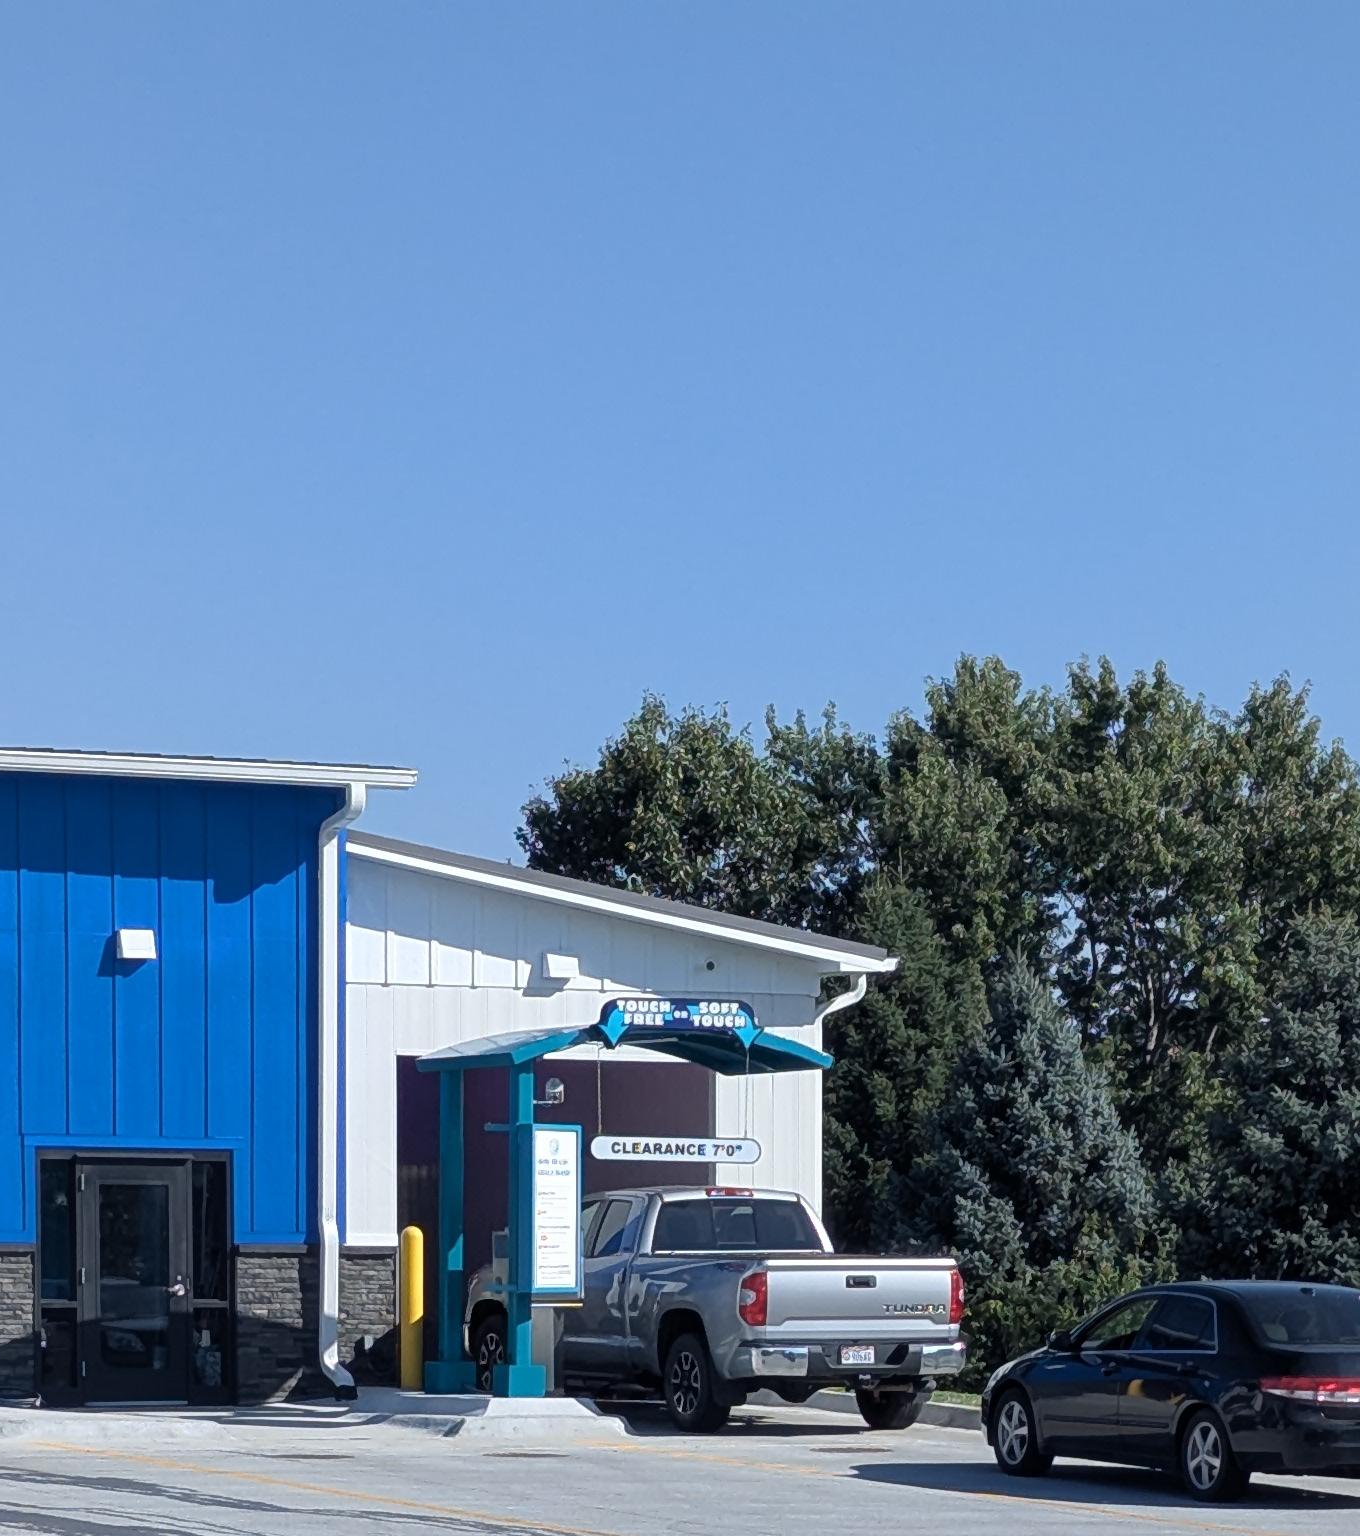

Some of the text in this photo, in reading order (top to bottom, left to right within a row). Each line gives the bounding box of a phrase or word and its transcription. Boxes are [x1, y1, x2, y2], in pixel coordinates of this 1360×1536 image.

[616, 1000, 671, 1013] TOUCH
[699, 1002, 739, 1015] SOFT
[623, 1013, 665, 1026] FREE
[692, 1015, 746, 1028] TOUCH
[611, 1141, 706, 1156] CLEARANCE
[882, 1303, 946, 1314] TUNDRA
